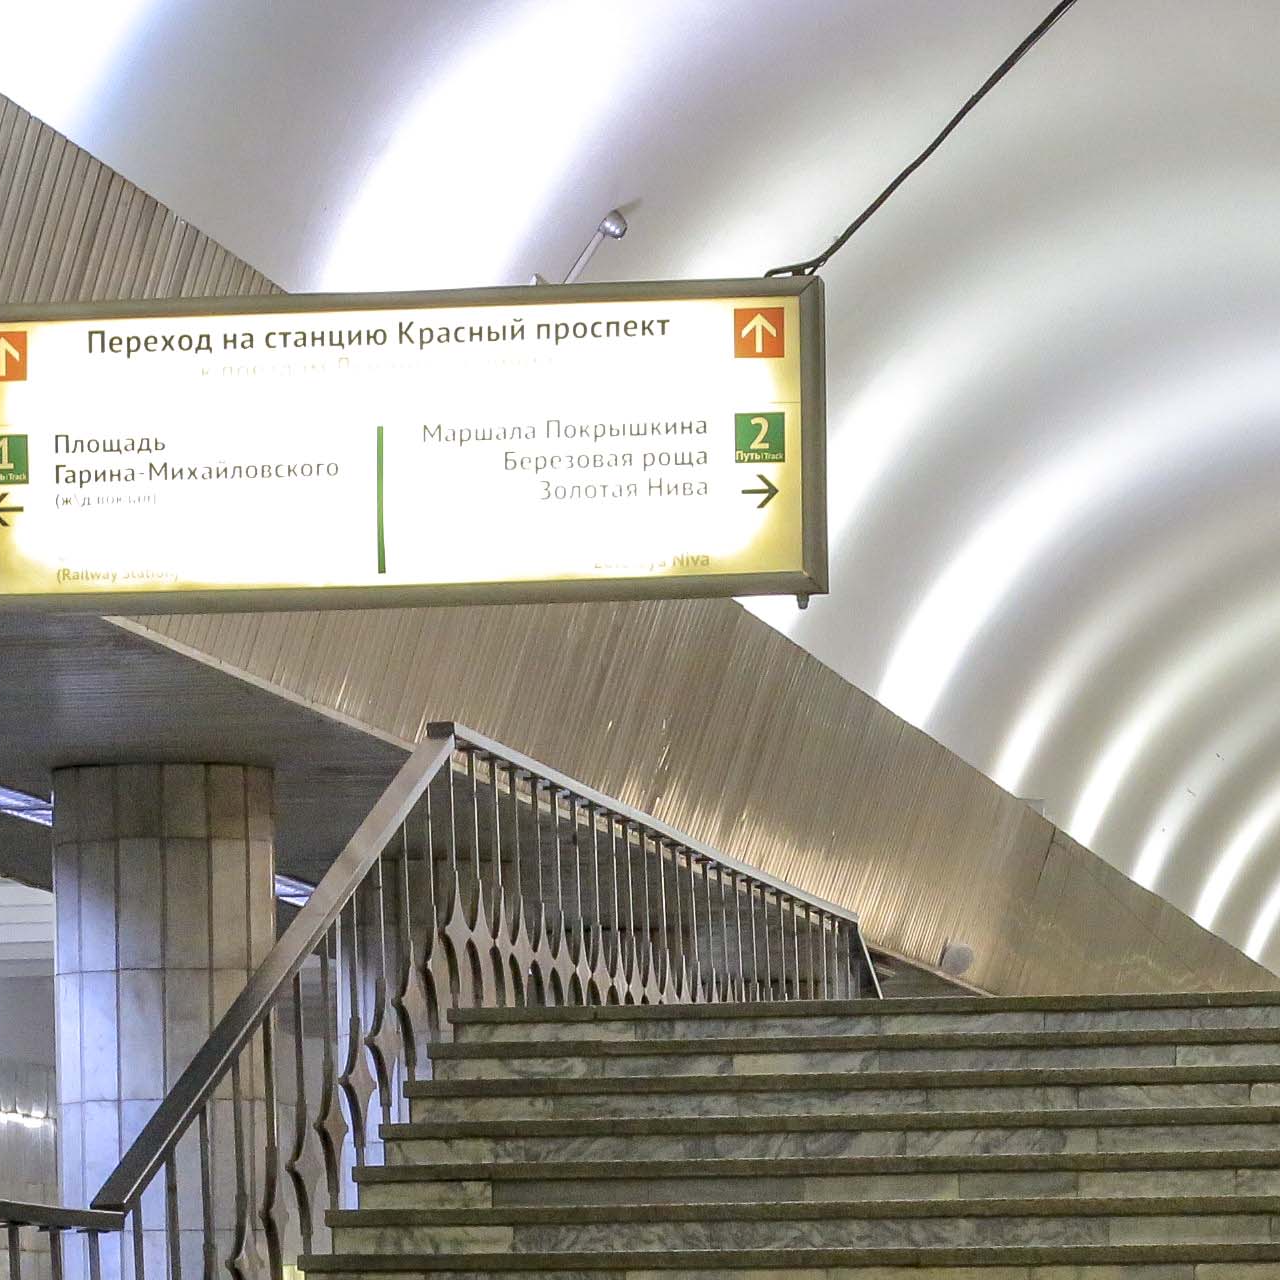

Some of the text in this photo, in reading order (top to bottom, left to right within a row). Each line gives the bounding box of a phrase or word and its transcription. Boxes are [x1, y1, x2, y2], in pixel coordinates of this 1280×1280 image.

[87, 317, 671, 360] Переход на станцию Красный проспект
[54, 433, 166, 456] Площадь
[423, 419, 708, 448] Маршала Покрышкина
[750, 416, 770, 449] 2
[55, 460, 339, 489] Гарина-Михайловского
[504, 450, 708, 475] Березовая роща
[540, 477, 708, 501] Золотая Нива
[672, 551, 710, 568] Niva
[56, 567, 118, 584] (Railway
